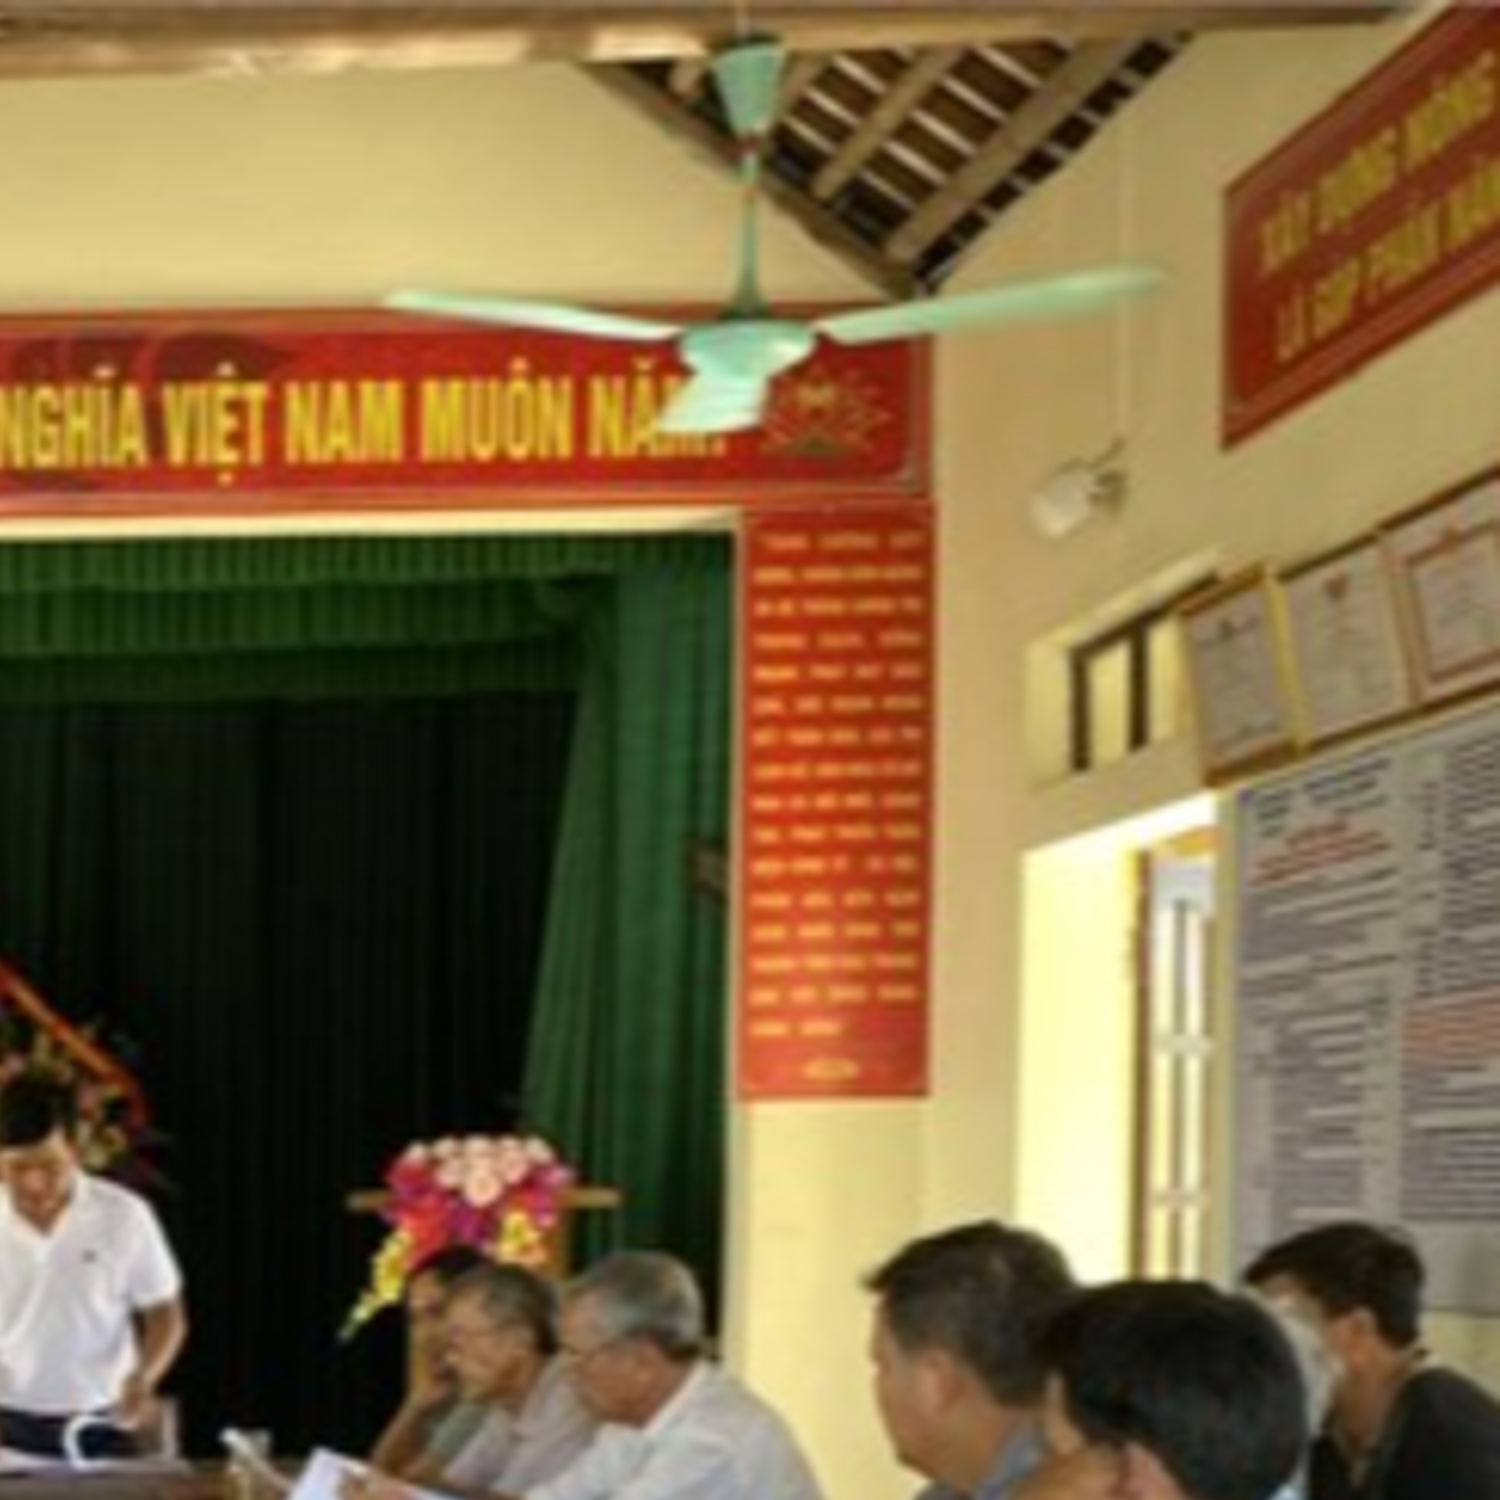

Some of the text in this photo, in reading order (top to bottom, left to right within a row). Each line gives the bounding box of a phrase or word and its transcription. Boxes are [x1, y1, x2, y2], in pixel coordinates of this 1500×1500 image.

[161, 363, 268, 485] VIỆT
[284, 379, 404, 464] NAM
[421, 357, 573, 461] MUÔN
[588, 357, 727, 458] NĂ
